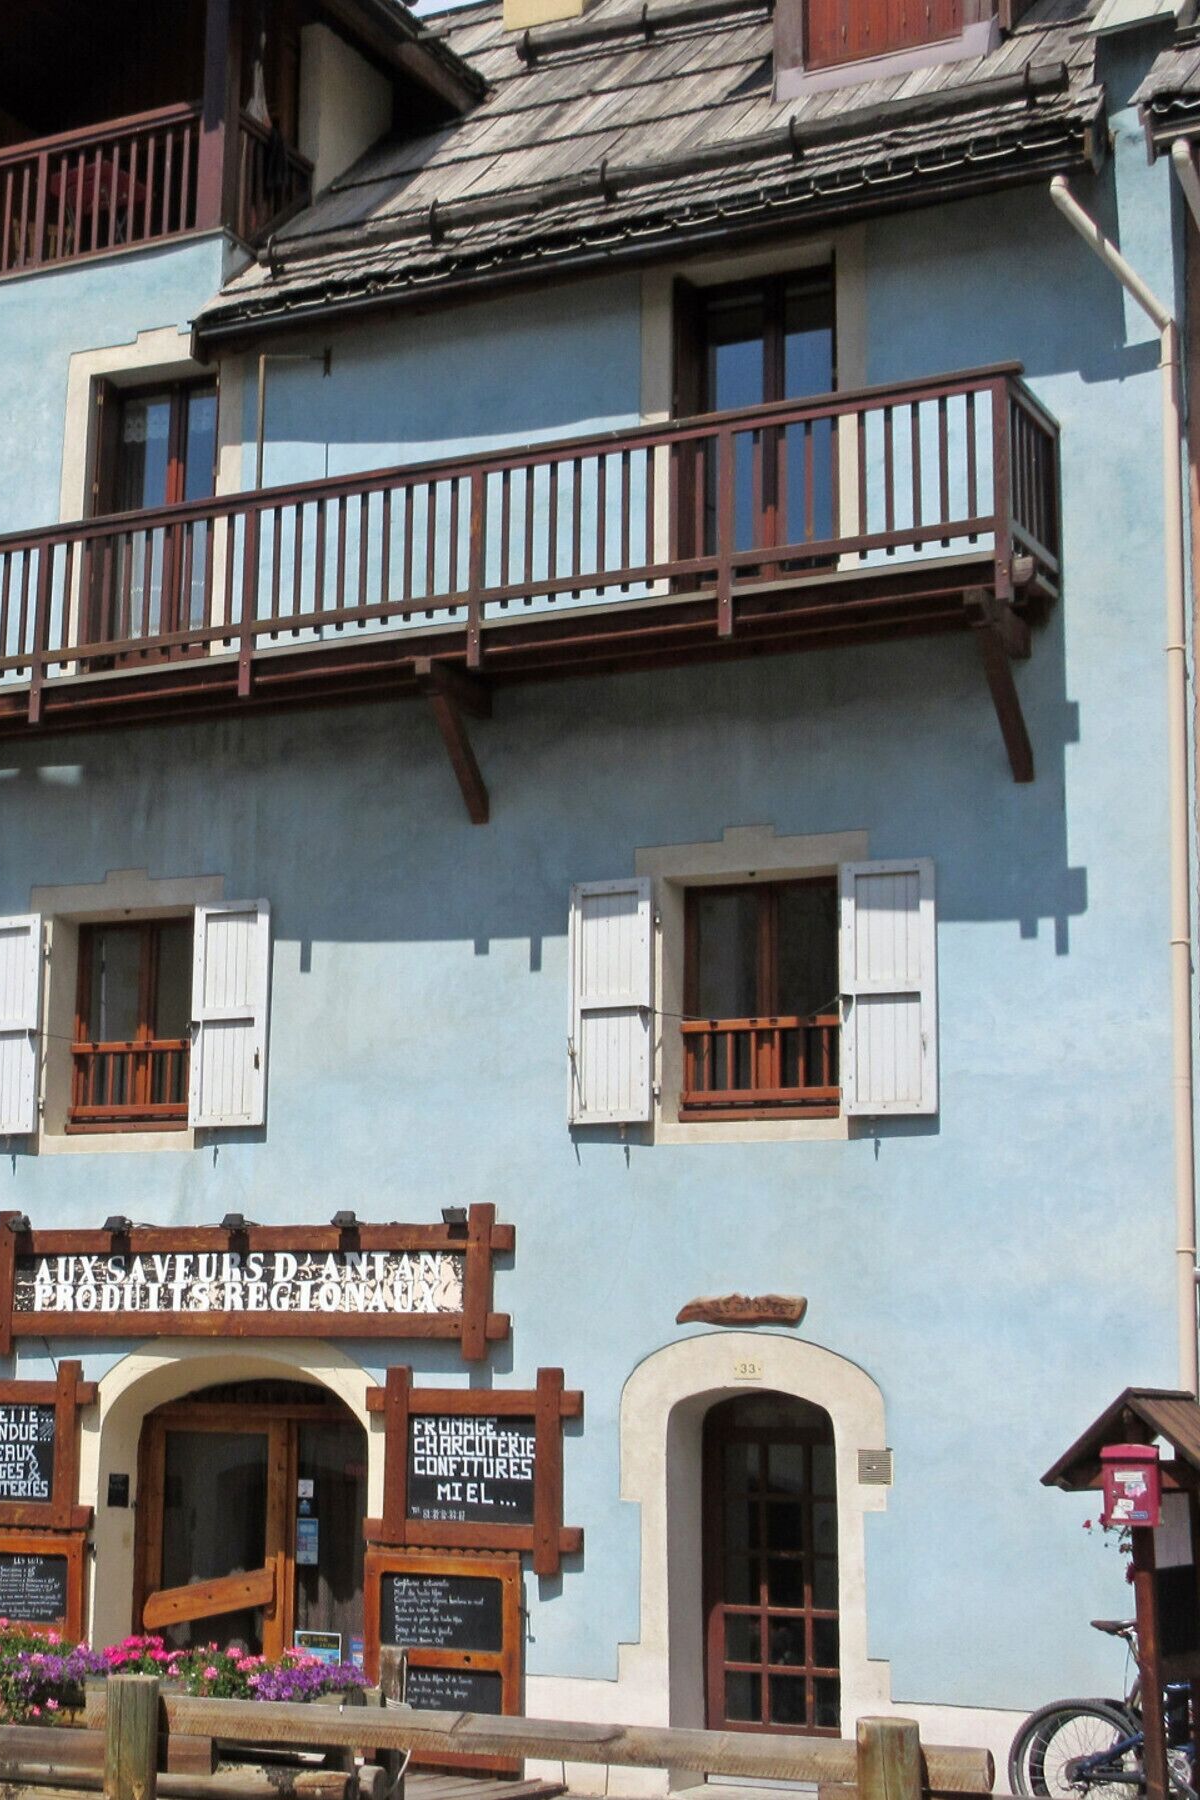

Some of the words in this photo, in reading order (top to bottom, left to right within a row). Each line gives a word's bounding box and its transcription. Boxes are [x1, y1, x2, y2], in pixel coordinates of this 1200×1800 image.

[35, 1255, 98, 1284] AUX
[106, 1252, 264, 1284] SAVEURS
[34, 1284, 210, 1312] PRODUITS
[223, 1281, 439, 1312] REGIONAUX
[740, 1363, 756, 1374] 33
[413, 1436, 536, 1458] CHARCUTERIE
[28, 1460, 40, 1481] &
[413, 1456, 533, 1480] CONFITURES
